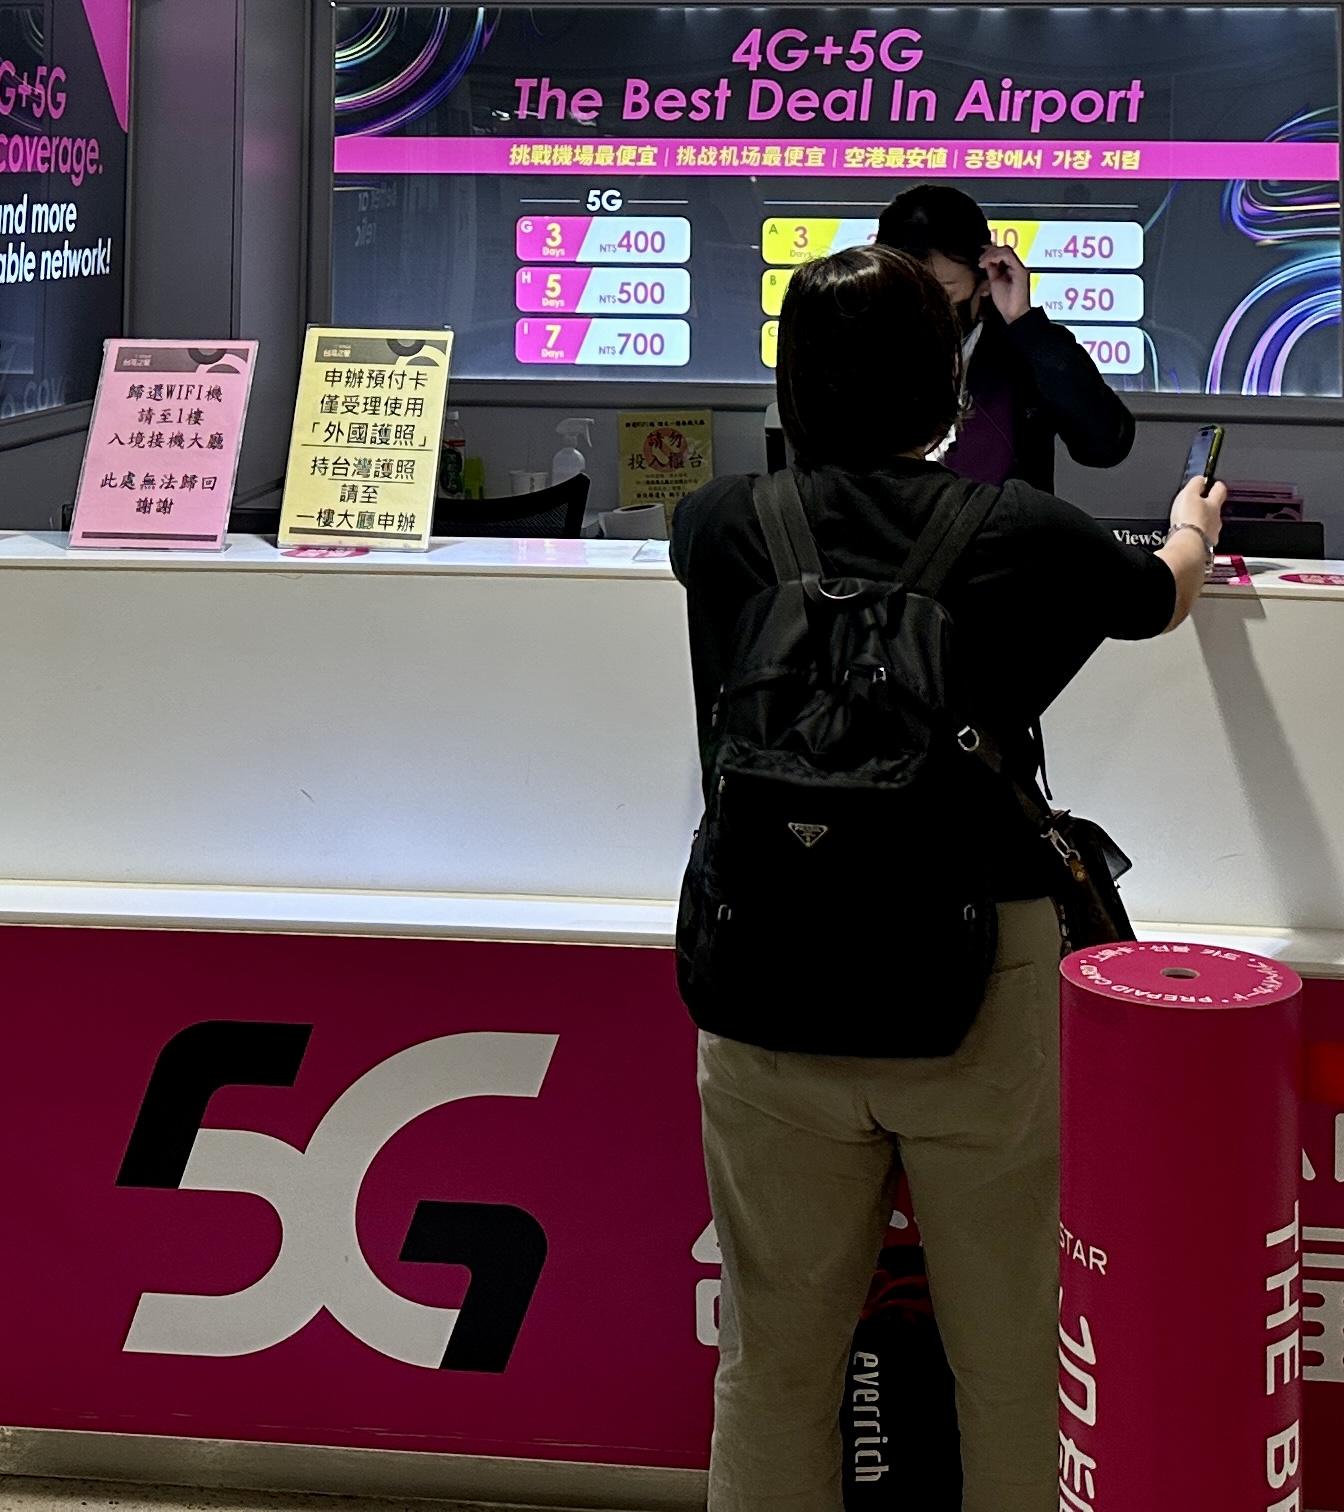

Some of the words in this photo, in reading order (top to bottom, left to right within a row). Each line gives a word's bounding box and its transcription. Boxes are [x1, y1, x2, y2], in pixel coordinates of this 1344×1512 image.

[731, 27, 923, 73] 4G+5G
[514, 78, 603, 120] The
[622, 79, 732, 121] Best
[747, 79, 872, 122] Deal
[889, 79, 937, 122] In
[956, 78, 1145, 132] Airport
[509, 144, 658, 166] 挑戰機場最便宜
[676, 145, 826, 167] 挑战机场最便宜
[964, 148, 1043, 170] 공항에서
[1052, 149, 1092, 170] 가장
[1100, 149, 1141, 171] 저렴
[586, 189, 623, 211] 5G
[31, 202, 77, 234] more
[520, 220, 534, 233] G
[545, 222, 562, 247] 3
[768, 224, 779, 235] A
[793, 226, 808, 248] 3
[40, 238, 112, 281] network!
[542, 246, 565, 257] Days
[521, 271, 531, 283] H
[545, 274, 561, 298] 5
[541, 298, 565, 308] Days
[545, 324, 562, 348] 7
[541, 348, 564, 359] Days
[324, 368, 428, 390] 申辦預付卡
[320, 394, 424, 417] 僅受理使用
[310, 456, 416, 480] 持台灣護照
[339, 483, 380, 504] 請至
[135, 497, 174, 515] 謝謝
[296, 508, 416, 532] 一樓大廳申辦
[1111, 984, 1213, 1003] PREPAID
[114, 1018, 561, 1374] 5G
[852, 1351, 890, 1482] everrich
